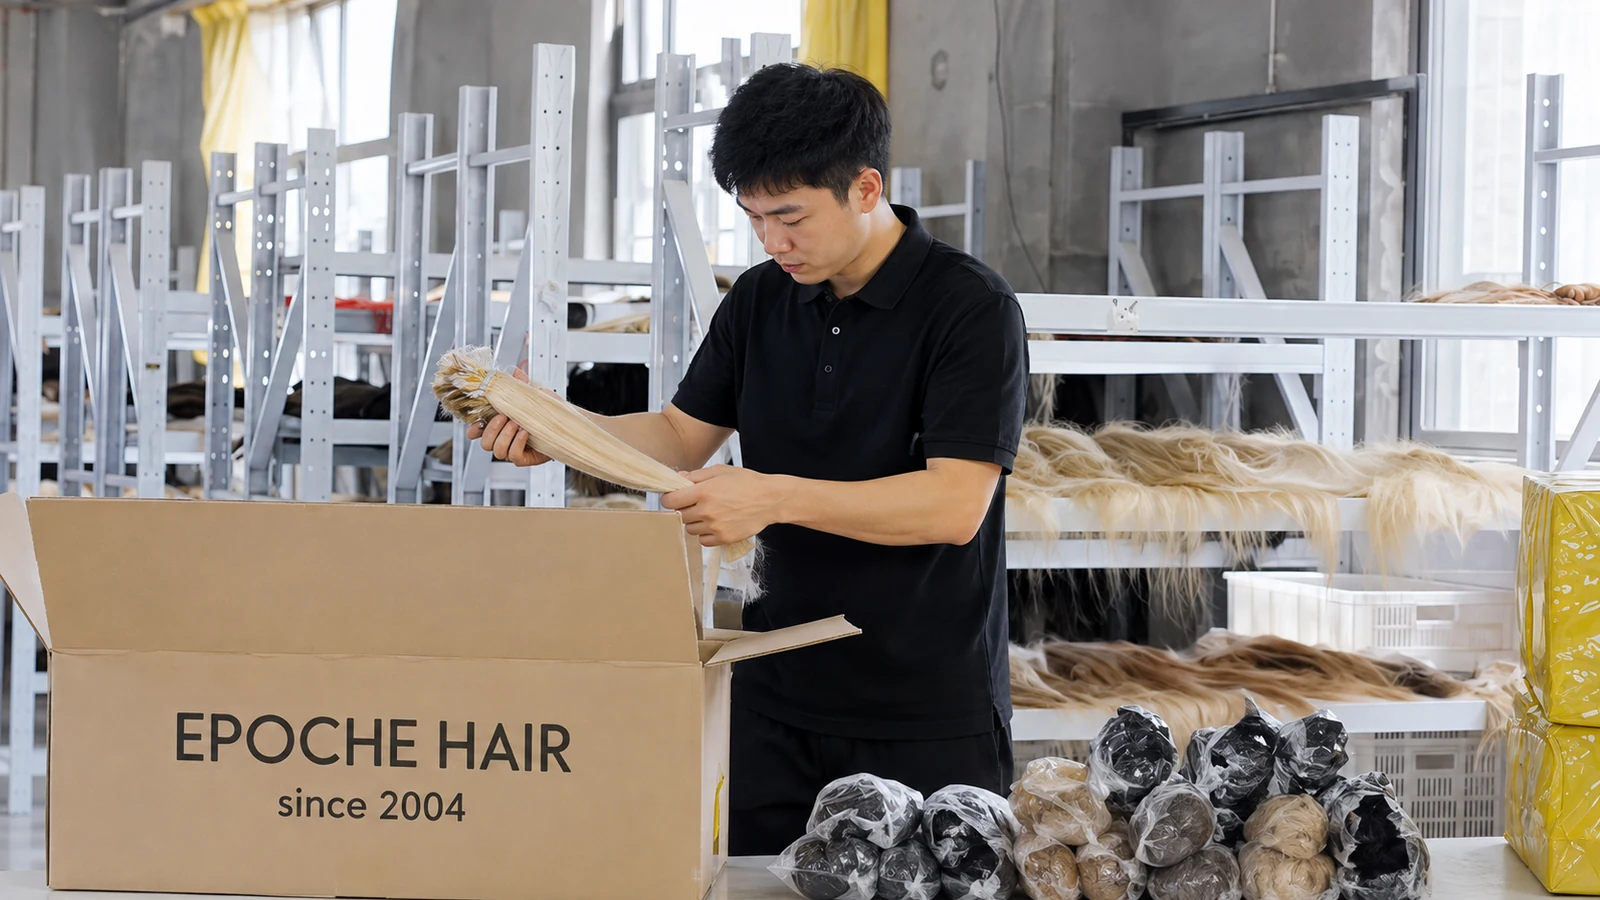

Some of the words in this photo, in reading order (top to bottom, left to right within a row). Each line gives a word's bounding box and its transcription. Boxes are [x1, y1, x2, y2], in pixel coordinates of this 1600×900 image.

[176, 712, 418, 768] EPOCHE
[439, 720, 572, 773] HAIR
[277, 787, 367, 819] since
[379, 790, 466, 822] 2004
